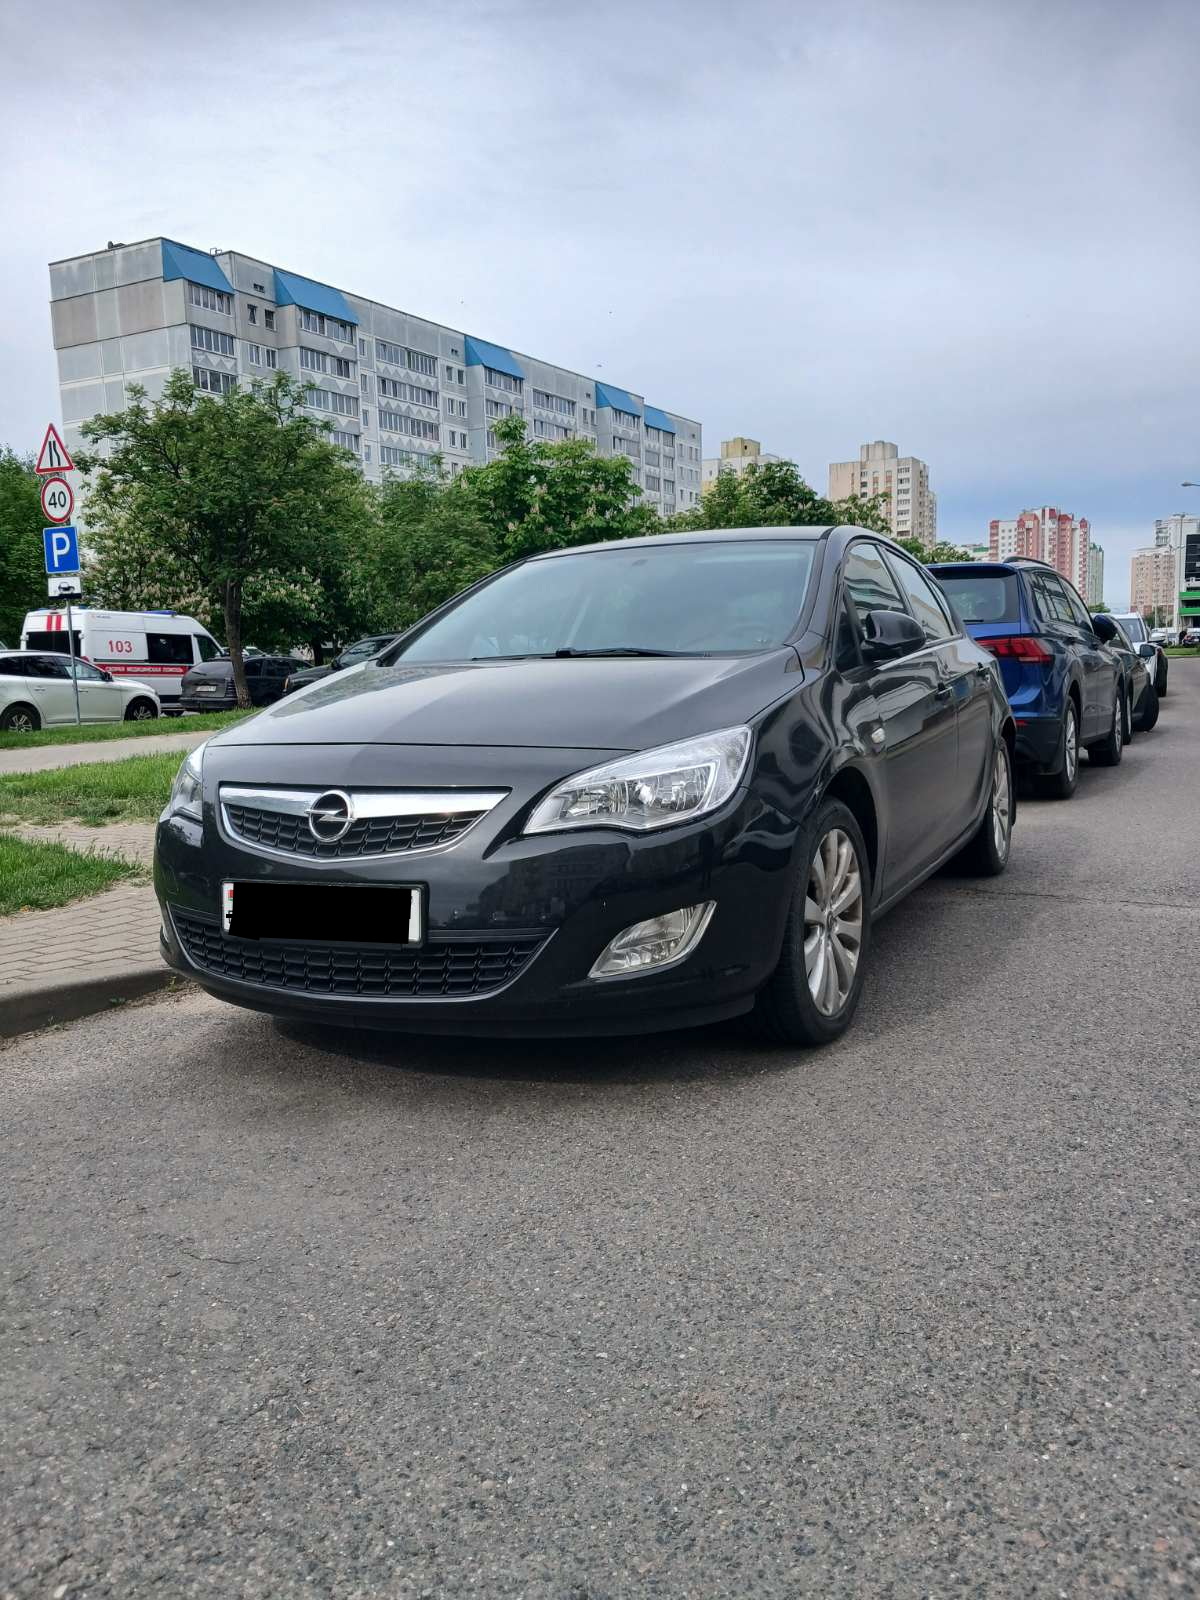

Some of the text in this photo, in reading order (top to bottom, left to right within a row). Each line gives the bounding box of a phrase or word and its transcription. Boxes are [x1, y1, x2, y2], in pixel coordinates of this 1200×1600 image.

[48, 491, 67, 508] 40
[52, 532, 71, 568] P
[108, 639, 133, 653] 103
